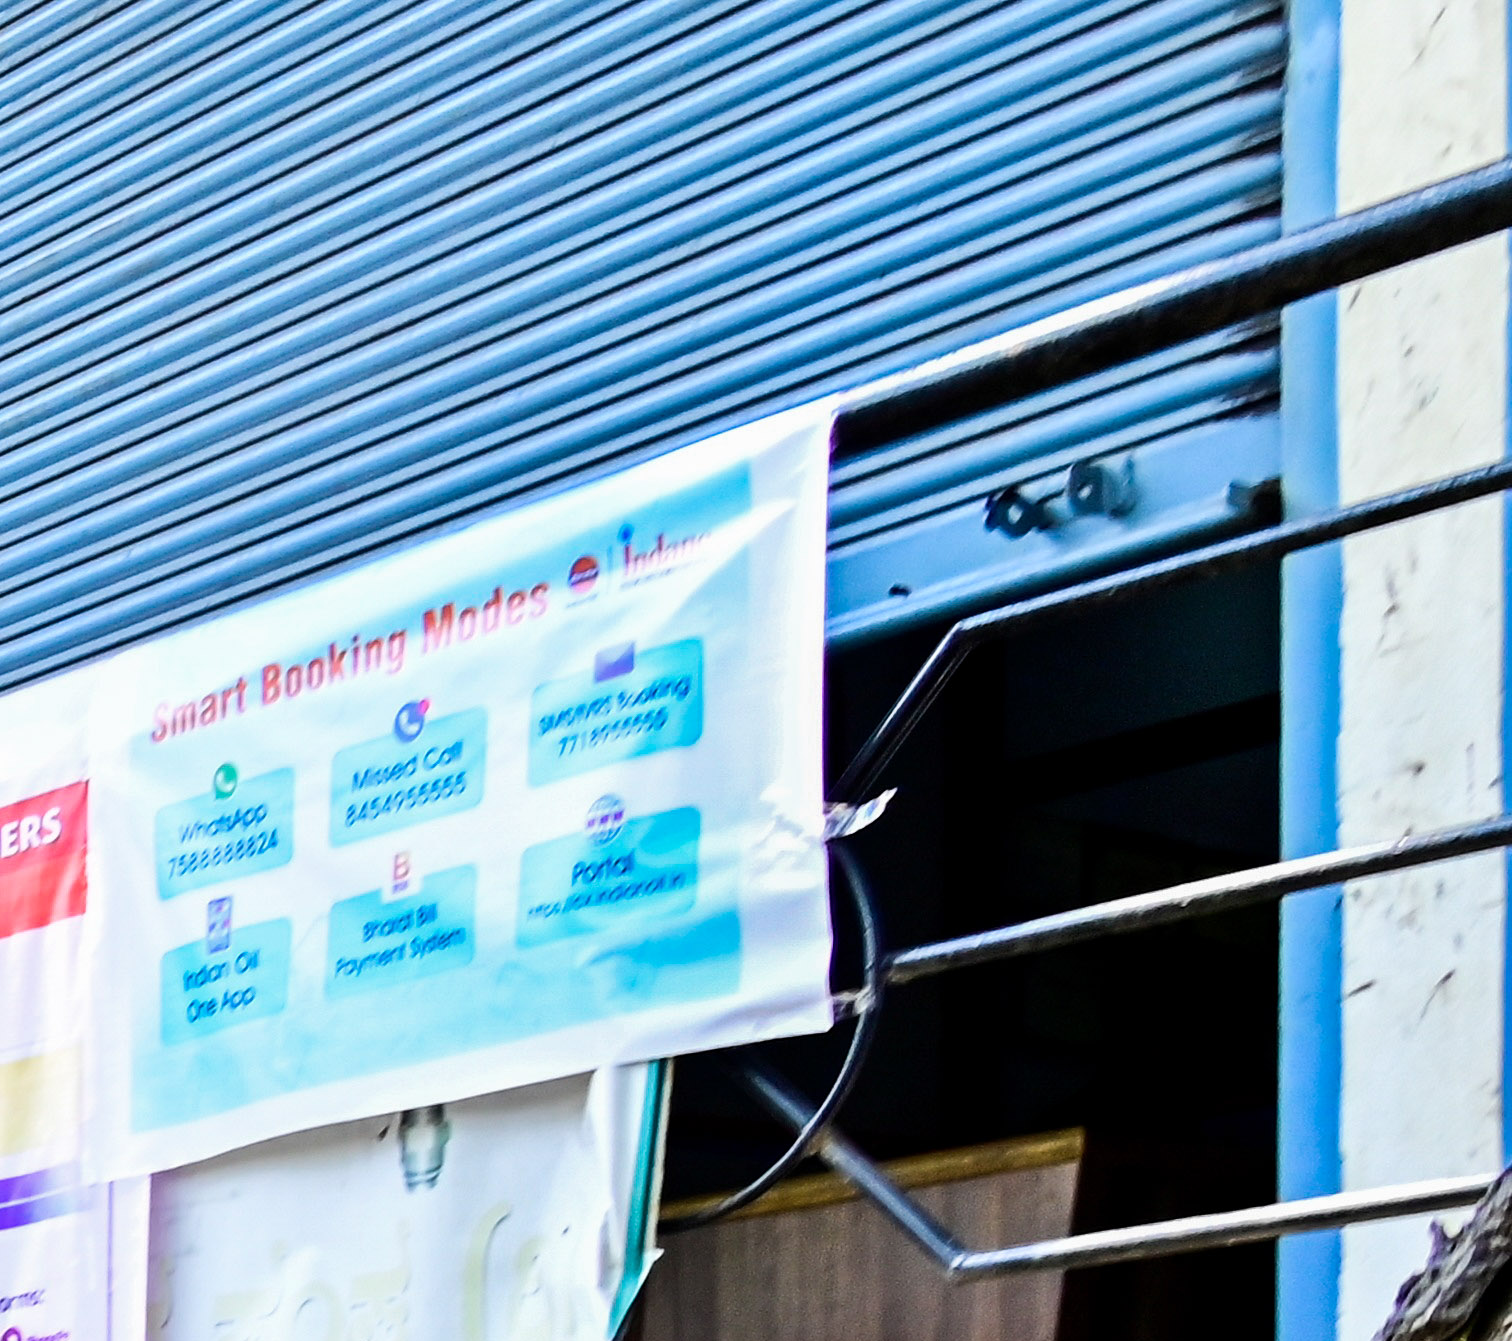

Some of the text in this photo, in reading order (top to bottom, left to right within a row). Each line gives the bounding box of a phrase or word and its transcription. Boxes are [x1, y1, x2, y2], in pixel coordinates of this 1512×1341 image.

[151, 583, 551, 743] Smart Booking Modes
[351, 739, 463, 793] Missed Call
[180, 803, 268, 843] WhatsApp
[571, 848, 636, 888] Portal
